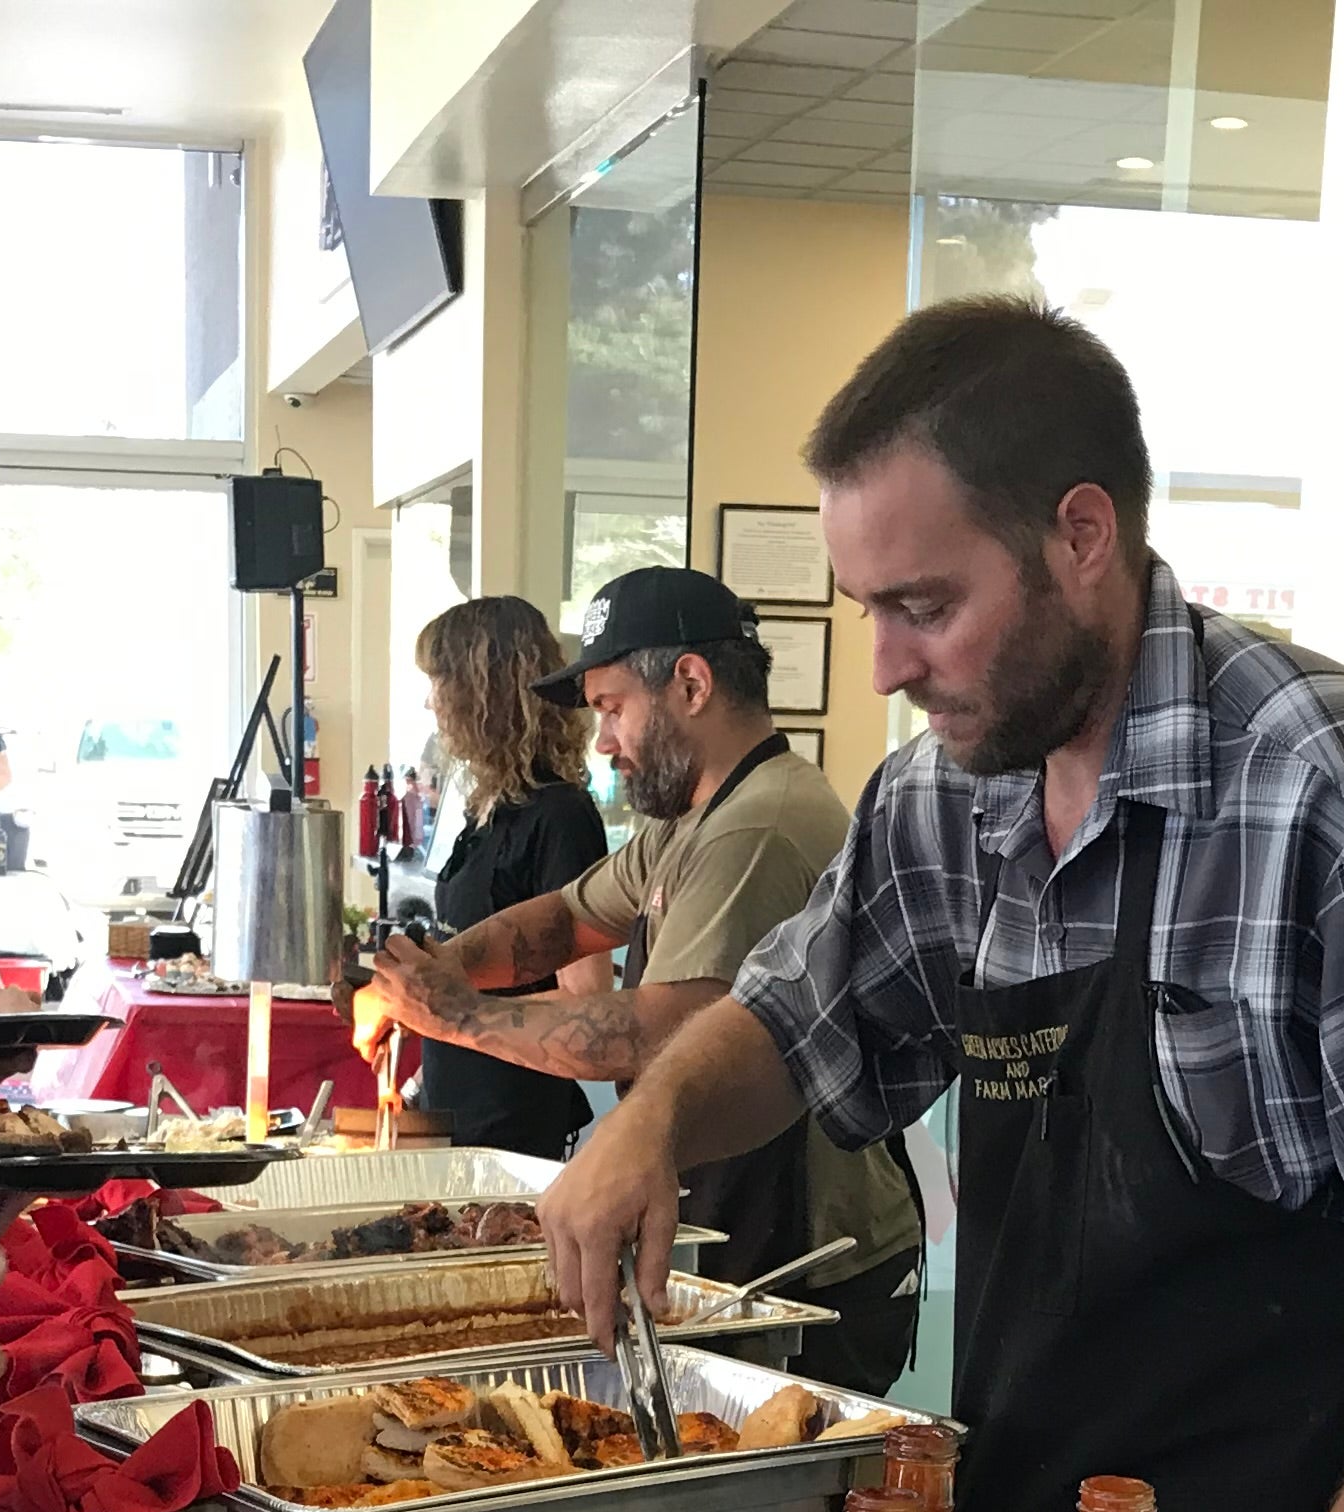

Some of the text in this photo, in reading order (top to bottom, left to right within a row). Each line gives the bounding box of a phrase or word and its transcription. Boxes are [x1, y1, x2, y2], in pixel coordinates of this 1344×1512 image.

[987, 1035, 1022, 1060] ACRES
[1006, 1061, 1030, 1079] AND
[974, 1080, 1011, 1101] FARM
